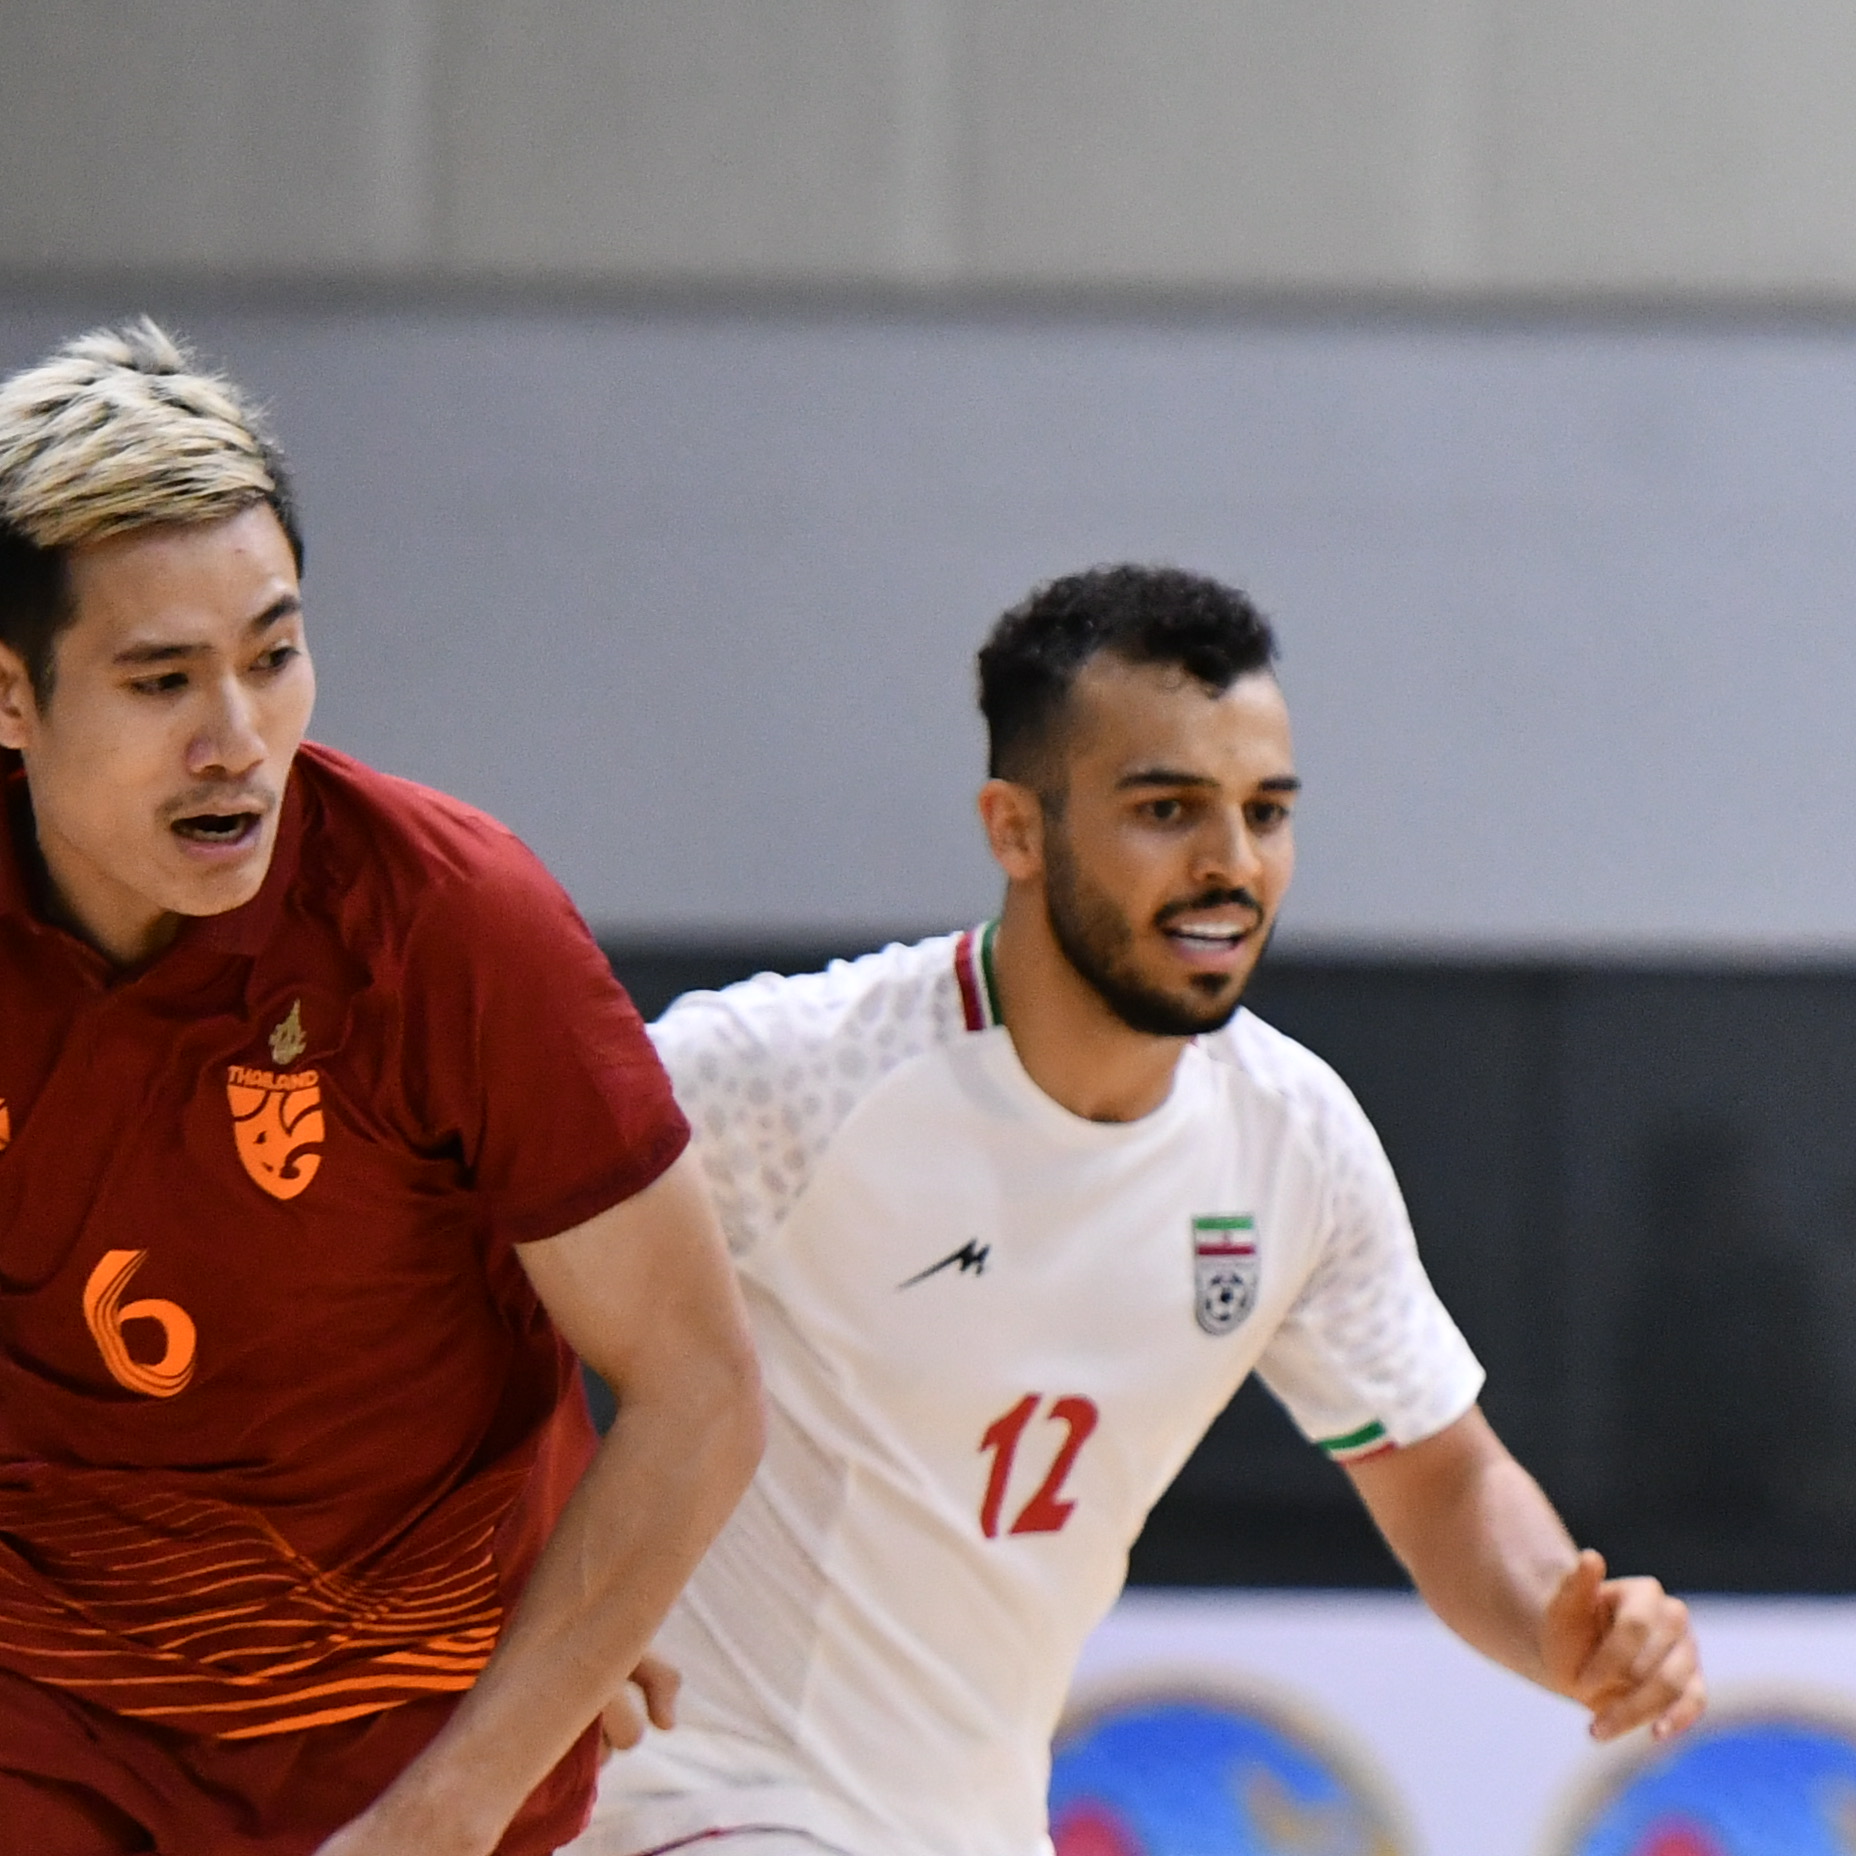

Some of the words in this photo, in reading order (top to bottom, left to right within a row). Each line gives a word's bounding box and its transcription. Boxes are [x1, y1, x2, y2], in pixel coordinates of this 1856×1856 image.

[227, 1065, 319, 1091] THAILAND
[83, 1248, 197, 1399] 6
[979, 1393, 1100, 1540] 12
